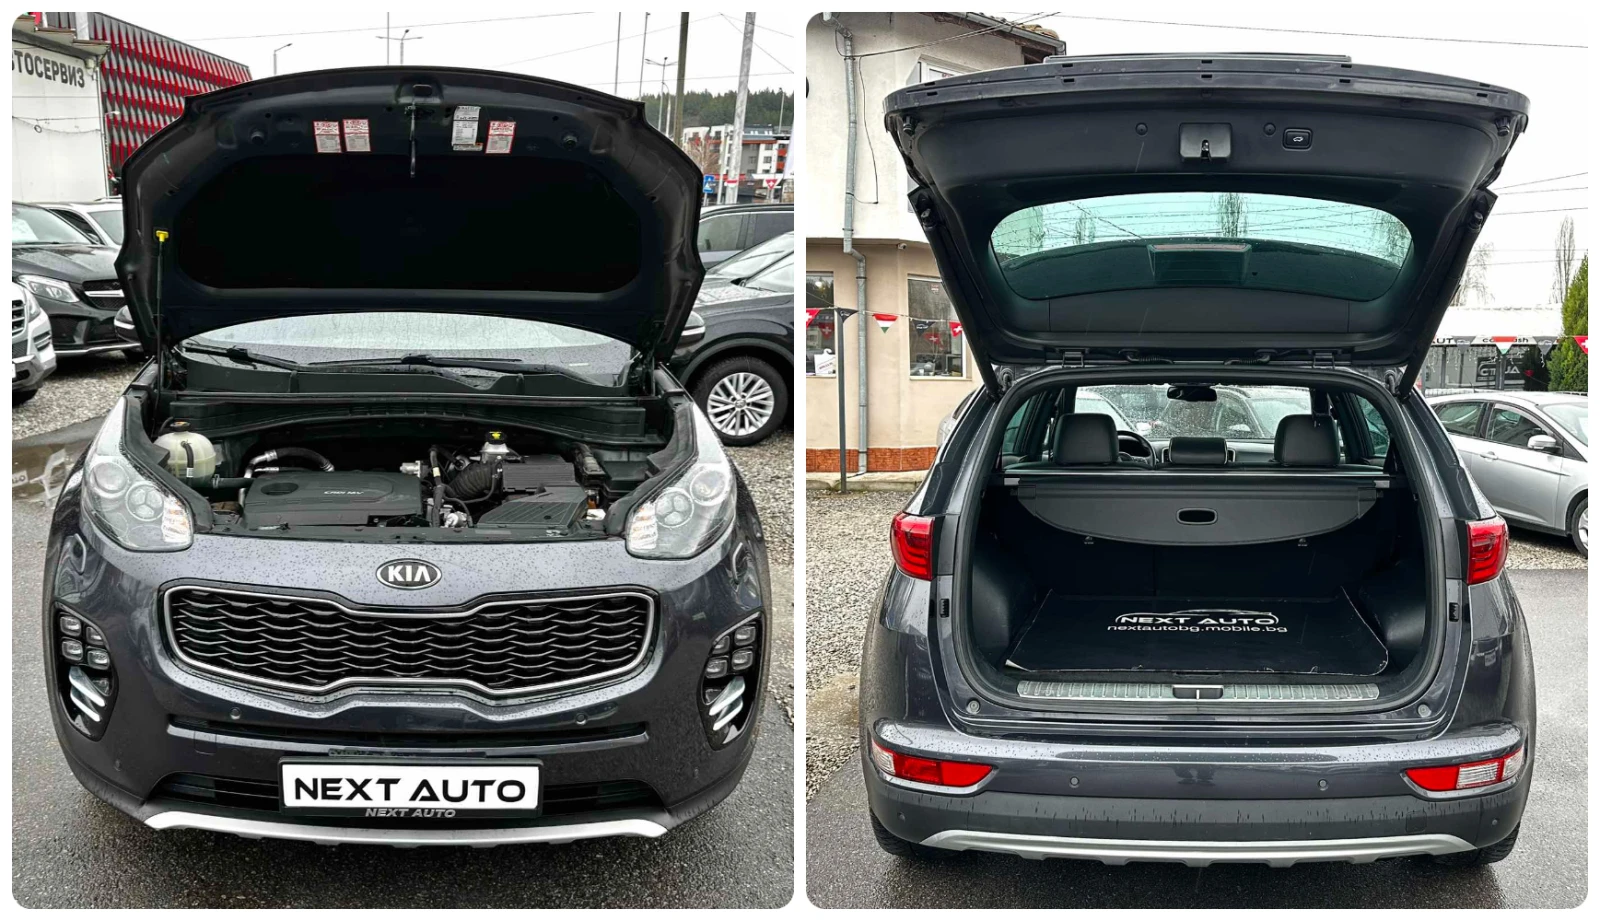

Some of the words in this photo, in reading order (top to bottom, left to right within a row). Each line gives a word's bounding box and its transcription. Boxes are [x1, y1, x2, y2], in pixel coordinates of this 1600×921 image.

[388, 565, 431, 582] KIA
[1120, 616, 1191, 624] NEXT
[1198, 617, 1276, 625] AUTO
[1107, 624, 1288, 633] nextautobg.mobile.bg
[295, 777, 401, 801] NEXT
[409, 778, 526, 803] AUTO
[365, 808, 409, 817] NEXT
[411, 808, 456, 818] AUTO
